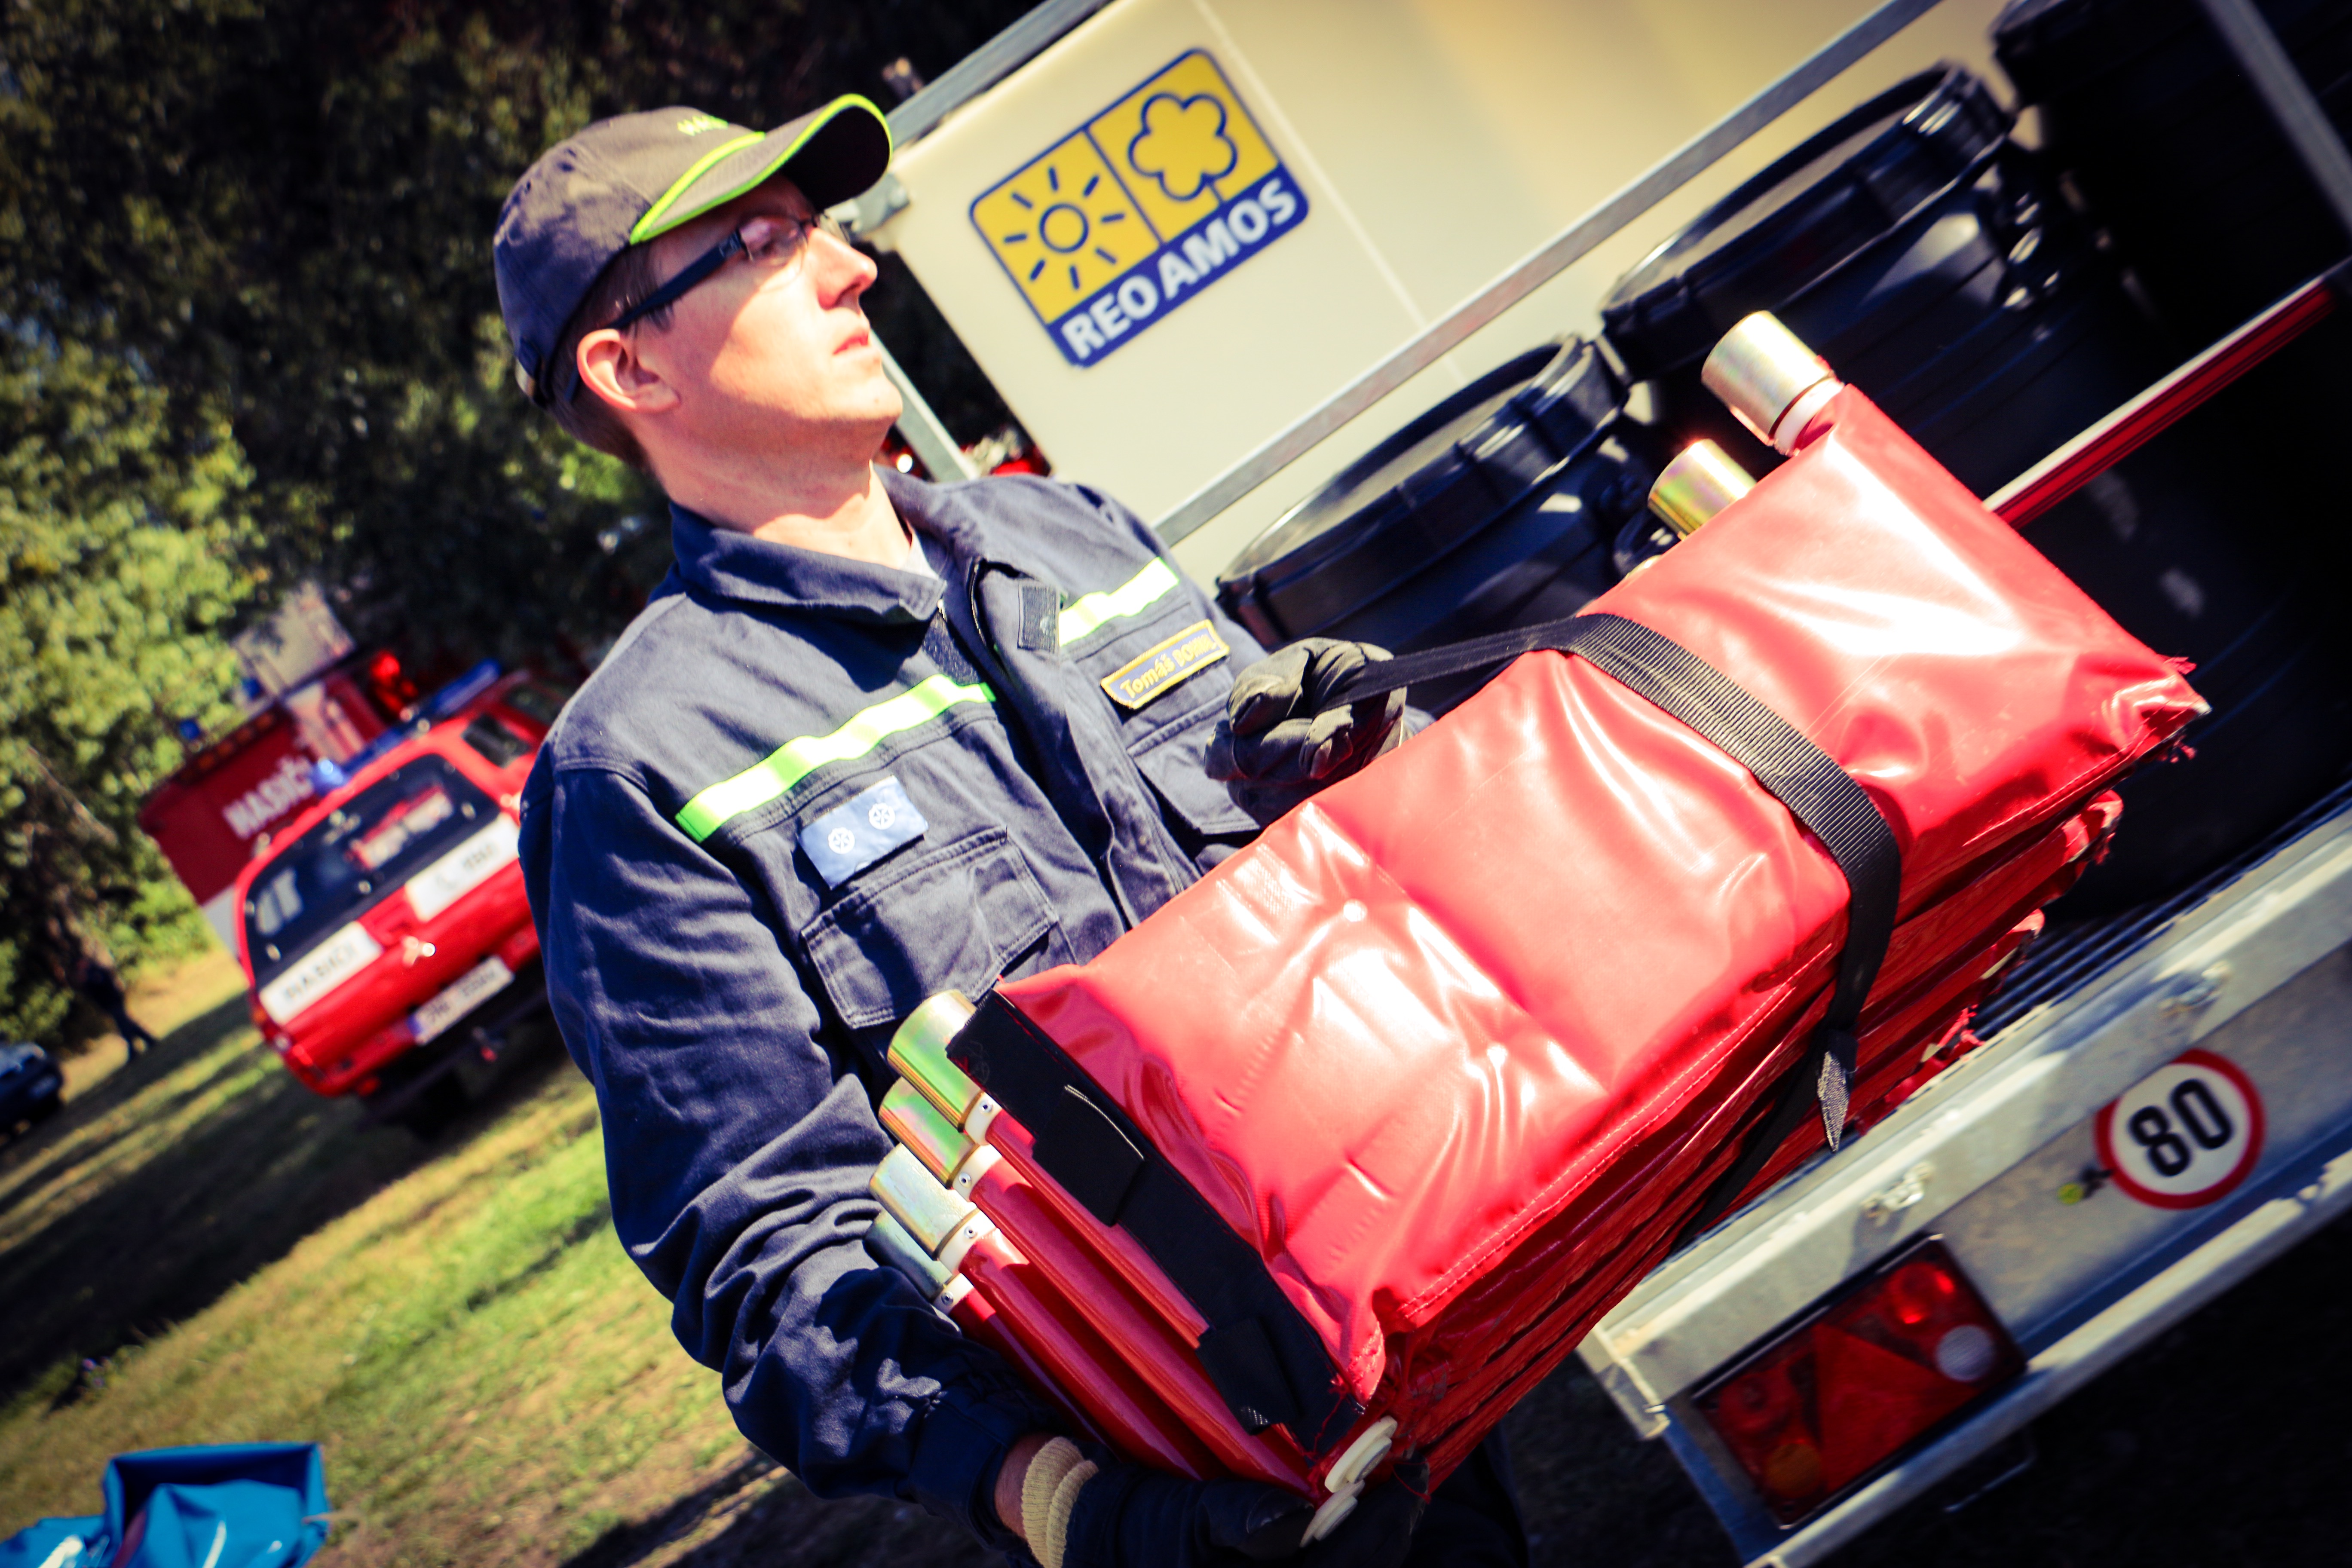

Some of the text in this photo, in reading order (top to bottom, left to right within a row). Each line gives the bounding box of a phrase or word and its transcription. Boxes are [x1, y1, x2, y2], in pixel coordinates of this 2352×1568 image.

[1062, 179, 1296, 359] REO AMOS
[1120, 654, 1175, 698] Tomáš
[2128, 1079, 2233, 1176] 80
